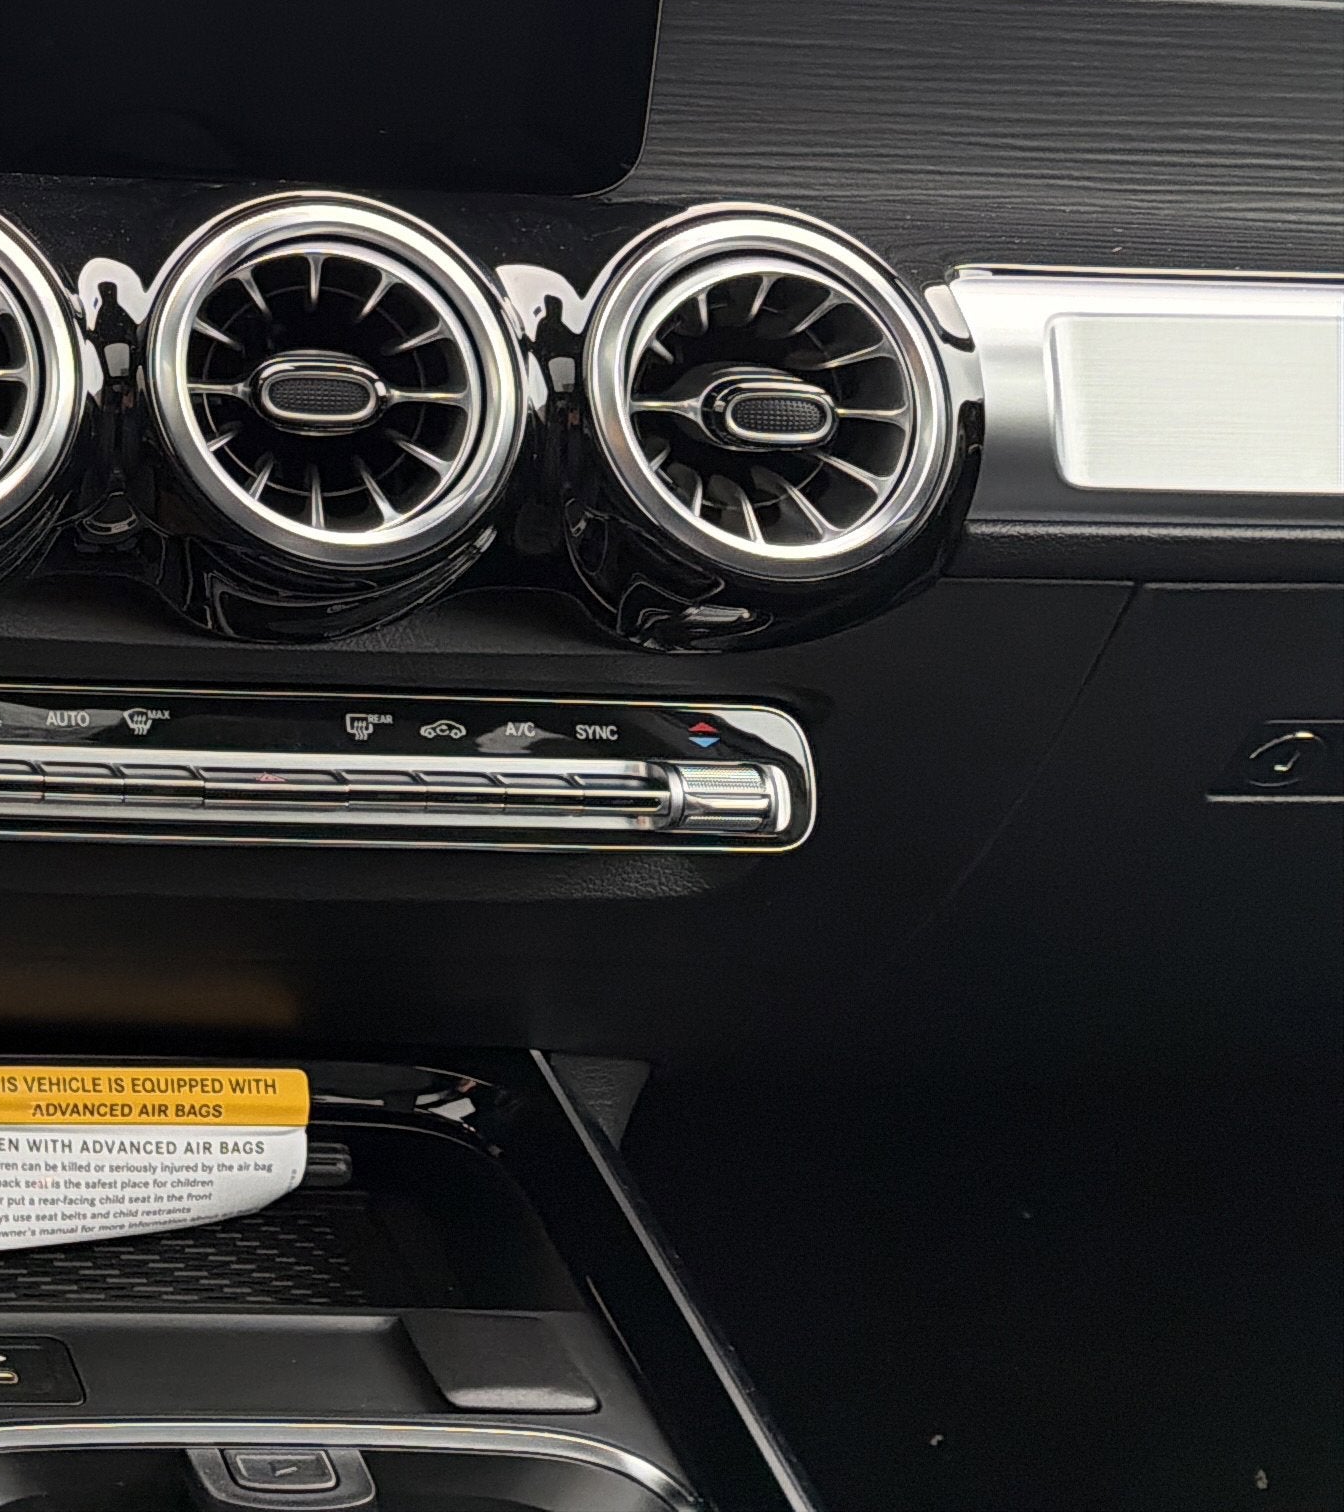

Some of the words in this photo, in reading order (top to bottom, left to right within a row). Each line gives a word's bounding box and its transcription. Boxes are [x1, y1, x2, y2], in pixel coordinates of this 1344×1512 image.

[45, 710, 91, 728] AUTO
[147, 709, 171, 720] MAX
[367, 714, 394, 725] REAR
[505, 722, 537, 738] A/C
[575, 725, 619, 741] SYNC
[23, 1076, 103, 1094] VEHICLE
[108, 1077, 125, 1094] IS
[131, 1078, 223, 1094] EQUIPPED
[228, 1078, 277, 1095] WITH
[32, 1103, 133, 1118] ADVANCED
[138, 1103, 169, 1118] AIR
[175, 1104, 223, 1119] BAGS
[26, 1138, 73, 1154] WITH
[80, 1139, 177, 1155] ADVANCED
[184, 1141, 212, 1155] AIR
[219, 1141, 265, 1155] BAGS
[21, 1162, 41, 1172] can
[45, 1159, 58, 1172] be
[61, 1161, 91, 1173] killed
[94, 1163, 105, 1173] or
[109, 1162, 158, 1174] seriously
[161, 1162, 199, 1175] injured
[201, 1163, 214, 1175] by
[216, 1162, 234, 1172] the
[237, 1162, 251, 1172] air
[253, 1161, 273, 1173] bag
[25, 1177, 49, 1189] seat
[51, 1178, 61, 1189] is
[64, 1178, 82, 1189] the
[85, 1178, 117, 1190] safest
[120, 1179, 150, 1191] place
[153, 1178, 167, 1188] for
[170, 1177, 214, 1188] children
[7, 1195, 25, 1207] put
[28, 1197, 35, 1206] a
[38, 1195, 96, 1207] rear-facing
[99, 1194, 125, 1205] child
[128, 1194, 151, 1204] seat
[153, 1193, 164, 1203] in
[167, 1193, 184, 1202] the
[186, 1192, 212, 1201] front
[12, 1213, 32, 1222] use
[35, 1212, 58, 1222] seat
[61, 1211, 88, 1221] belts
[90, 1210, 110, 1219] and
[113, 1207, 139, 1219] child
[141, 1206, 191, 1217] restraints
[39, 1225, 78, 1236] manual
[80, 1224, 96, 1233] for
